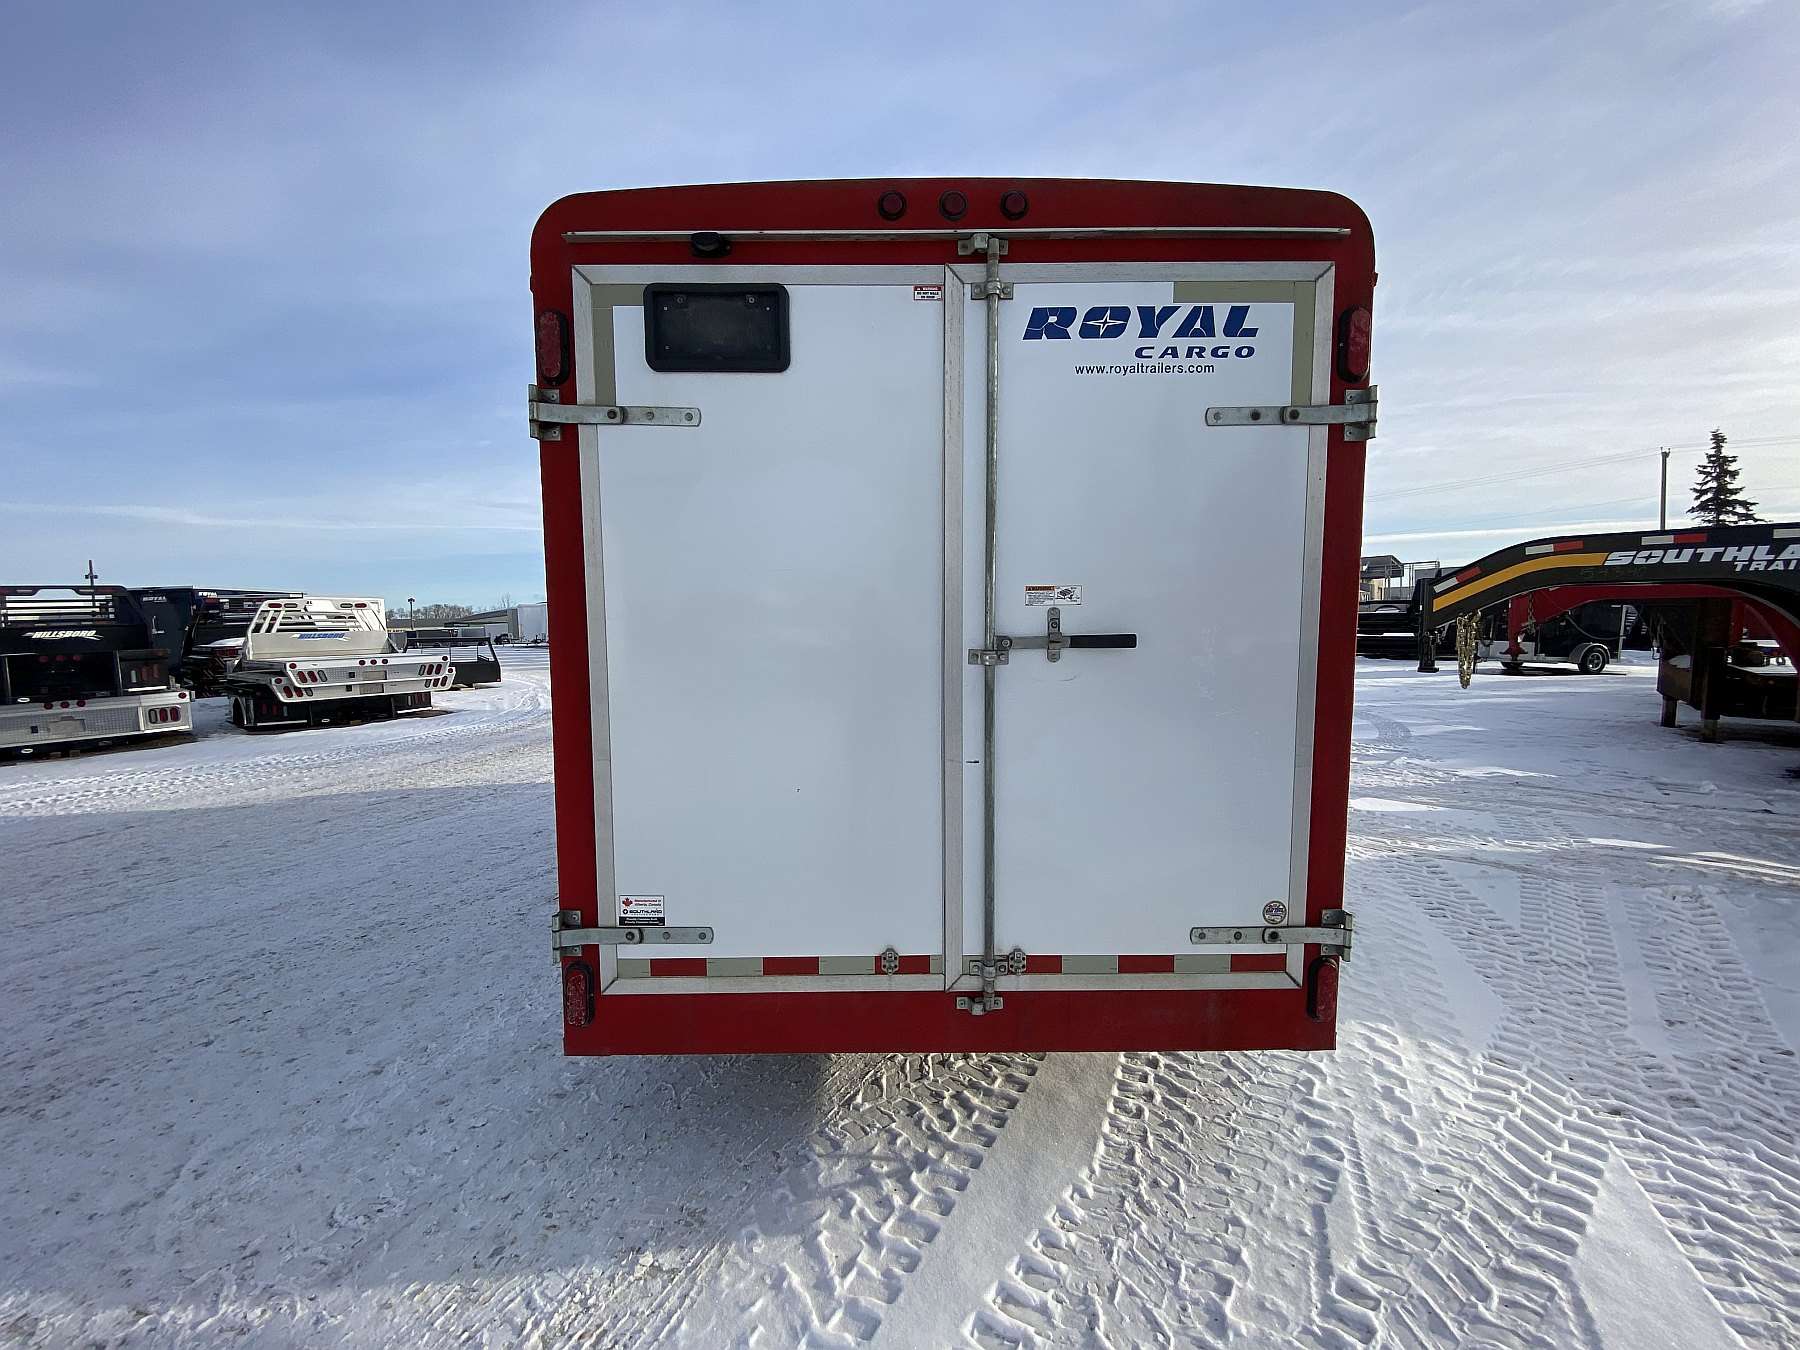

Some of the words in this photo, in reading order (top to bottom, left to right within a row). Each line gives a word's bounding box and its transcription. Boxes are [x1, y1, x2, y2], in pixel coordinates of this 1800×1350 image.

[1022, 305, 1259, 340] ROYAL
[1134, 345, 1255, 359] CARGO
[1074, 362, 1215, 376] www.royaltrailers.com
[32, 630, 96, 638] HILLSBORO
